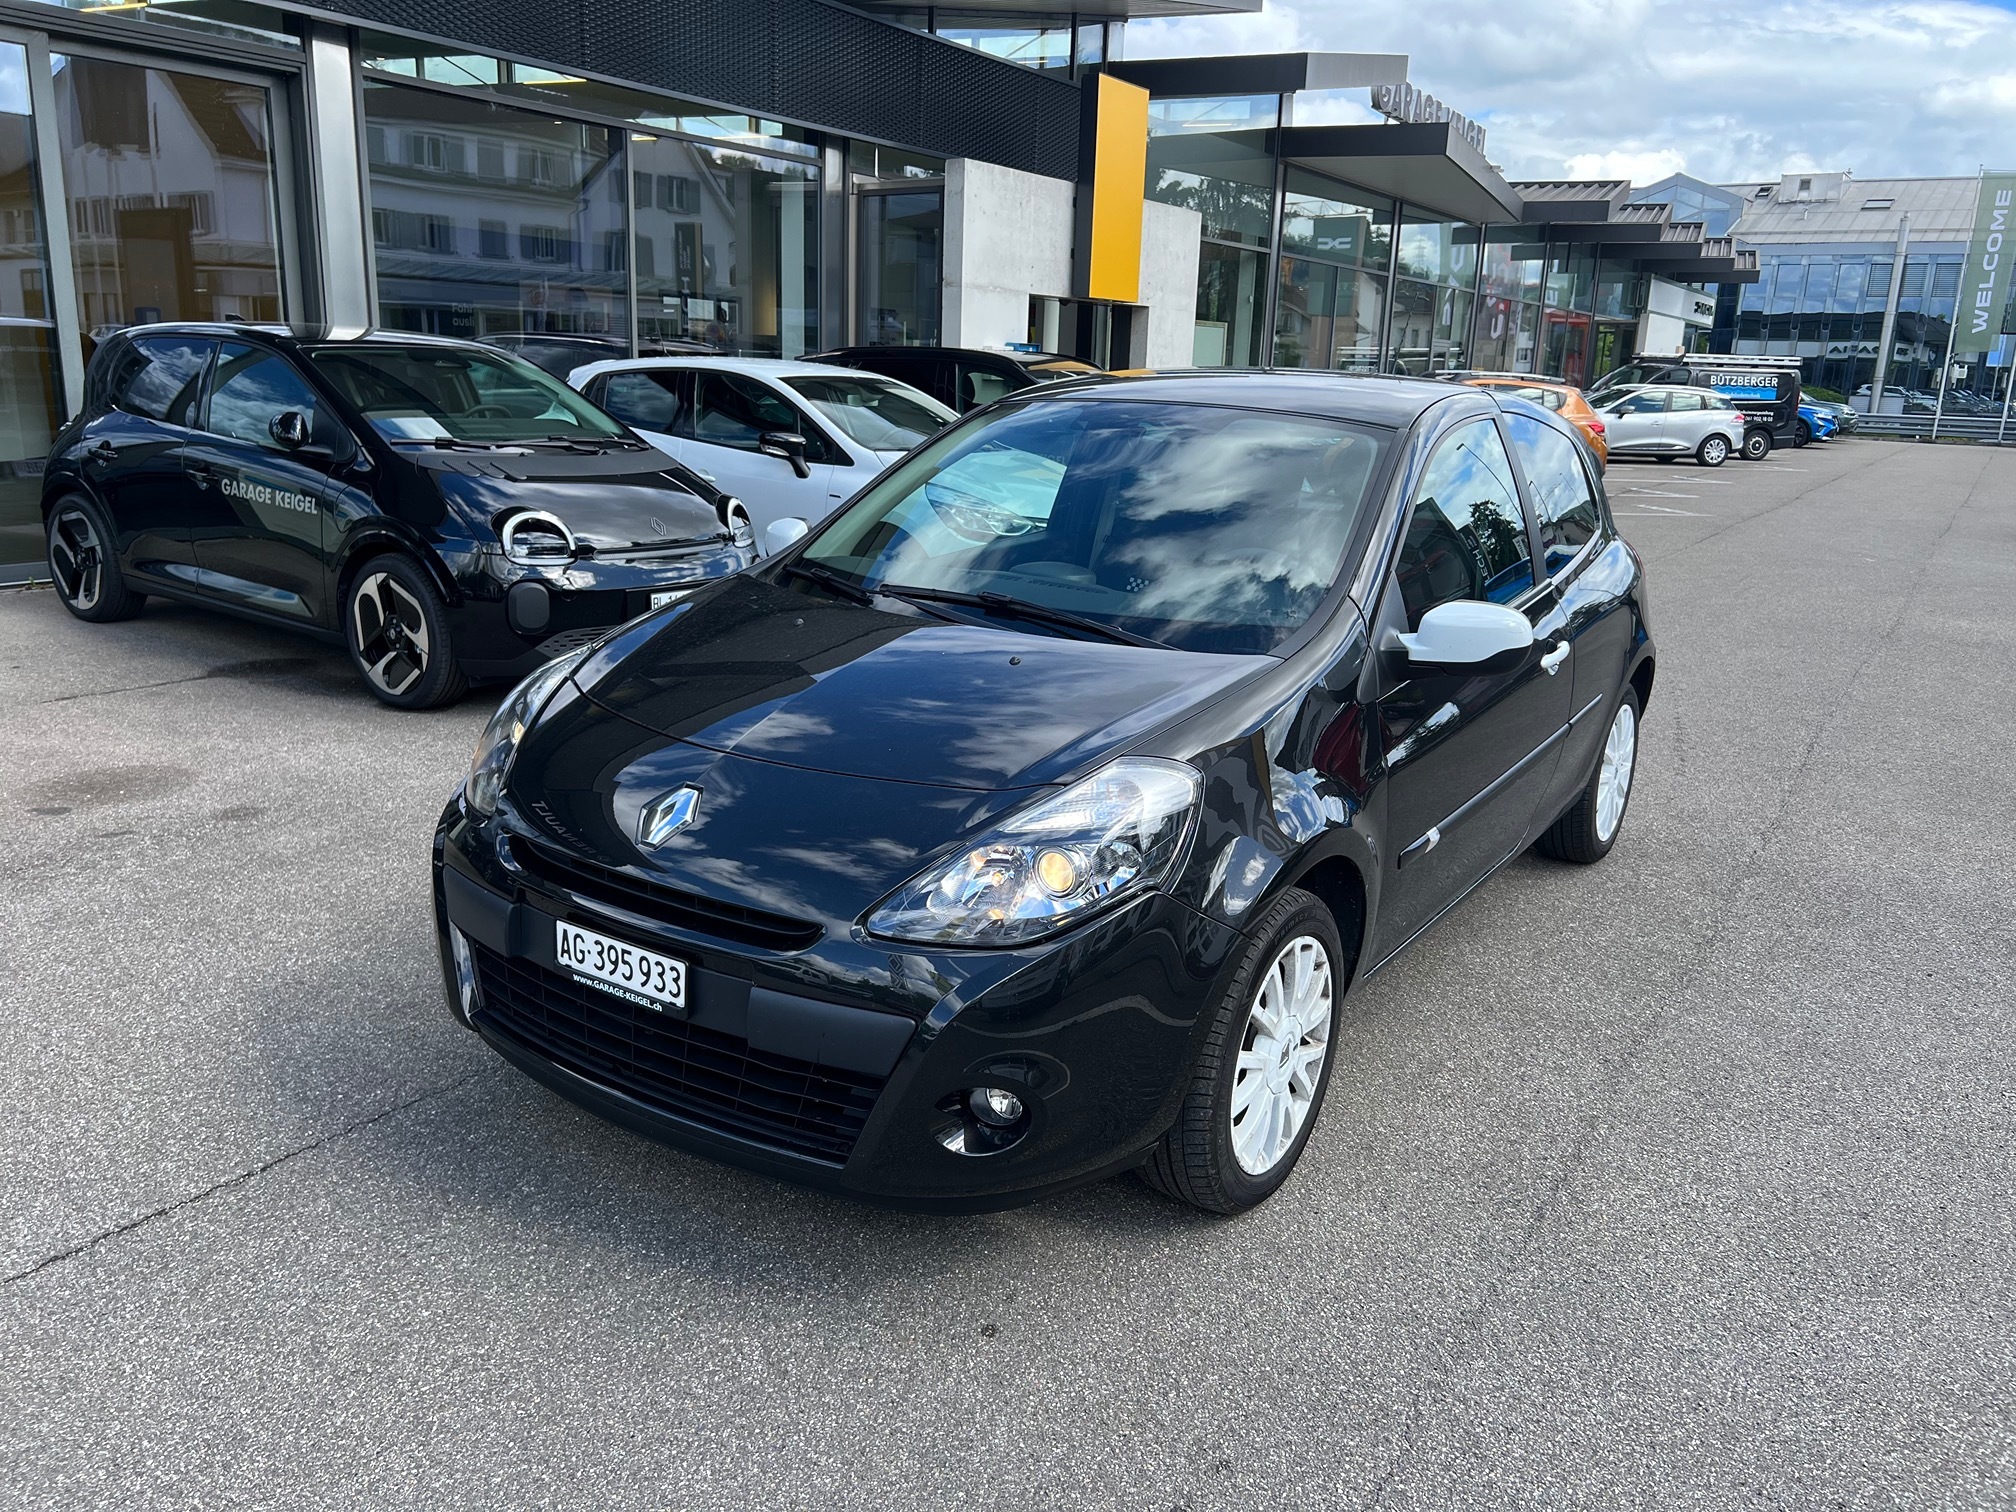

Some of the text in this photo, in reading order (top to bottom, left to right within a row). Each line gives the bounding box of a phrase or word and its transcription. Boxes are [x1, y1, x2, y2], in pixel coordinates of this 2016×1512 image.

[1972, 189, 2012, 334] WELCOME
[1710, 374, 1778, 387] BÜTZBERGER
[221, 479, 318, 514] GARAGE KEIGEL
[572, 973, 663, 1012] www.GARAGE-KEIGEL.ch
